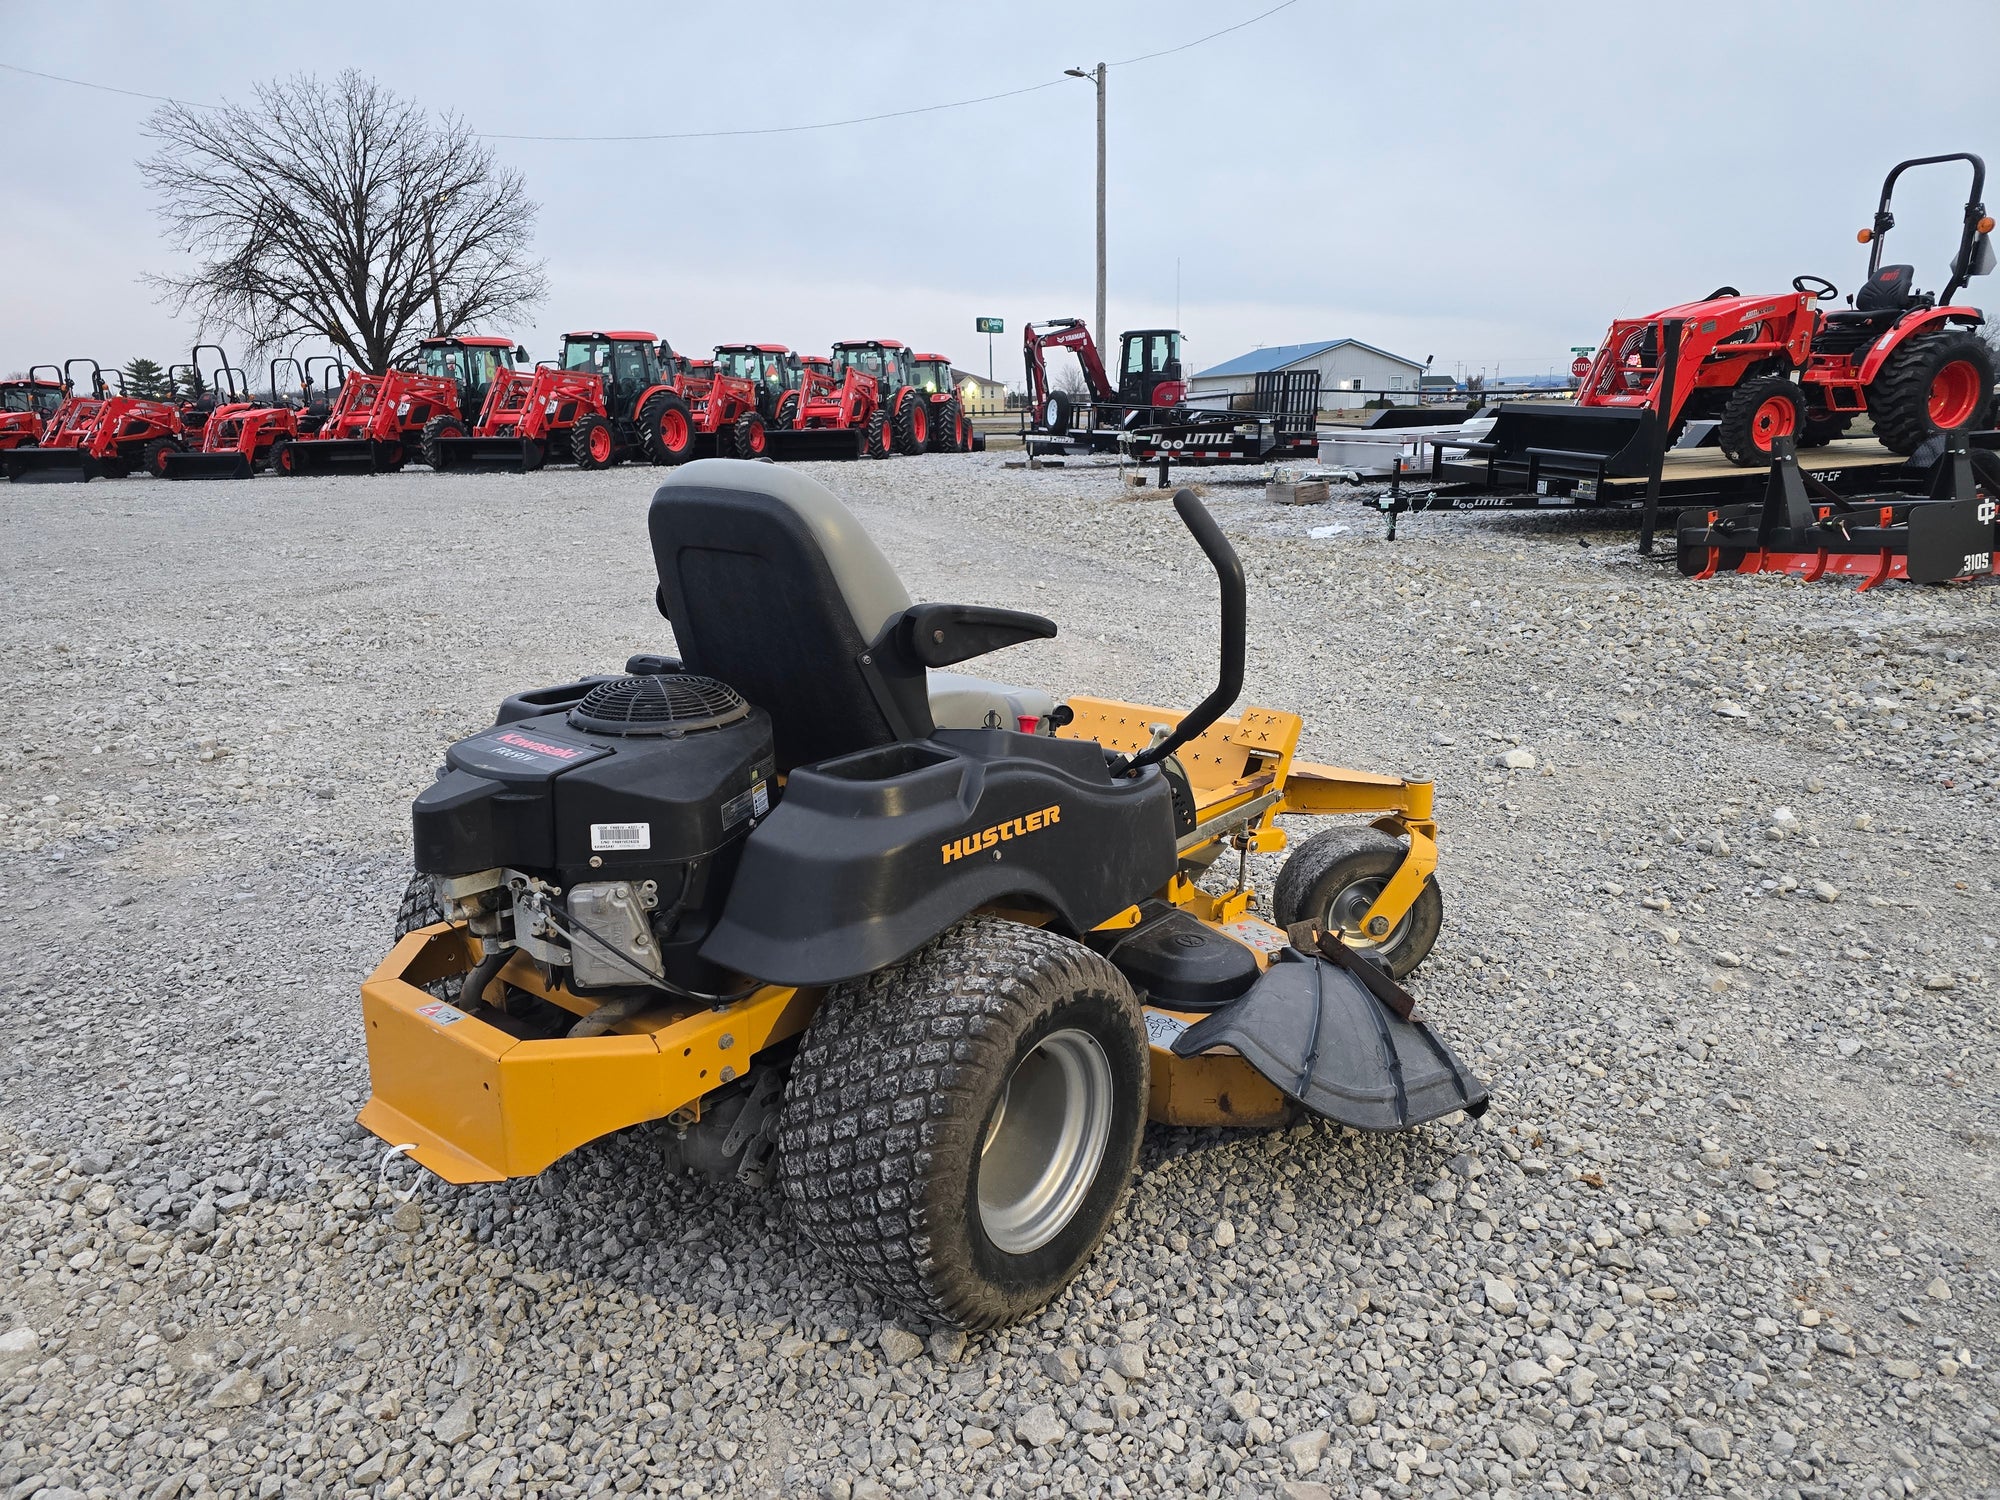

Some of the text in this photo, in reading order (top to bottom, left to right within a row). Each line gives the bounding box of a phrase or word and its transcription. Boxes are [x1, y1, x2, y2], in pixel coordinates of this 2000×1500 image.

[1064, 332, 1086, 342] YANMAR
[1572, 363, 1590, 372] STOP
[497, 733, 583, 760] Kawasaki
[941, 804, 1061, 865] HUSTLER
